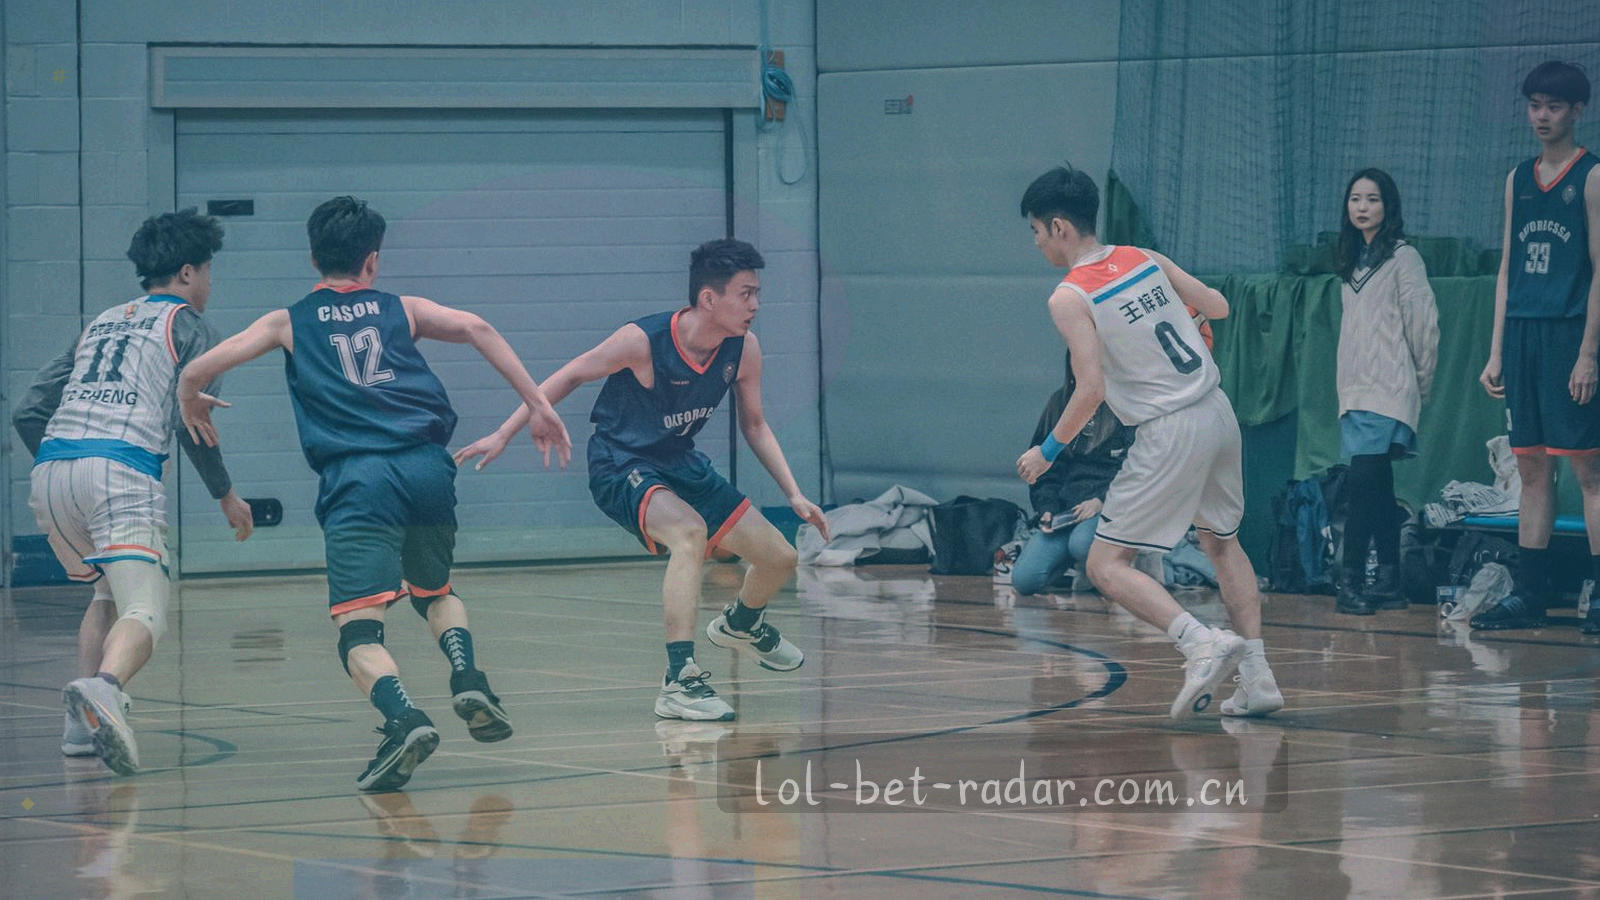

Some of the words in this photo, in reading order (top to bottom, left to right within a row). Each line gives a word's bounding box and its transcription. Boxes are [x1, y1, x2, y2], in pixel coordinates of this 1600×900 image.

[1525, 242, 1551, 274] 33
[317, 301, 380, 322] CASON
[81, 334, 130, 383] 11
[329, 326, 395, 387] 12
[1154, 320, 1202, 375] 0
